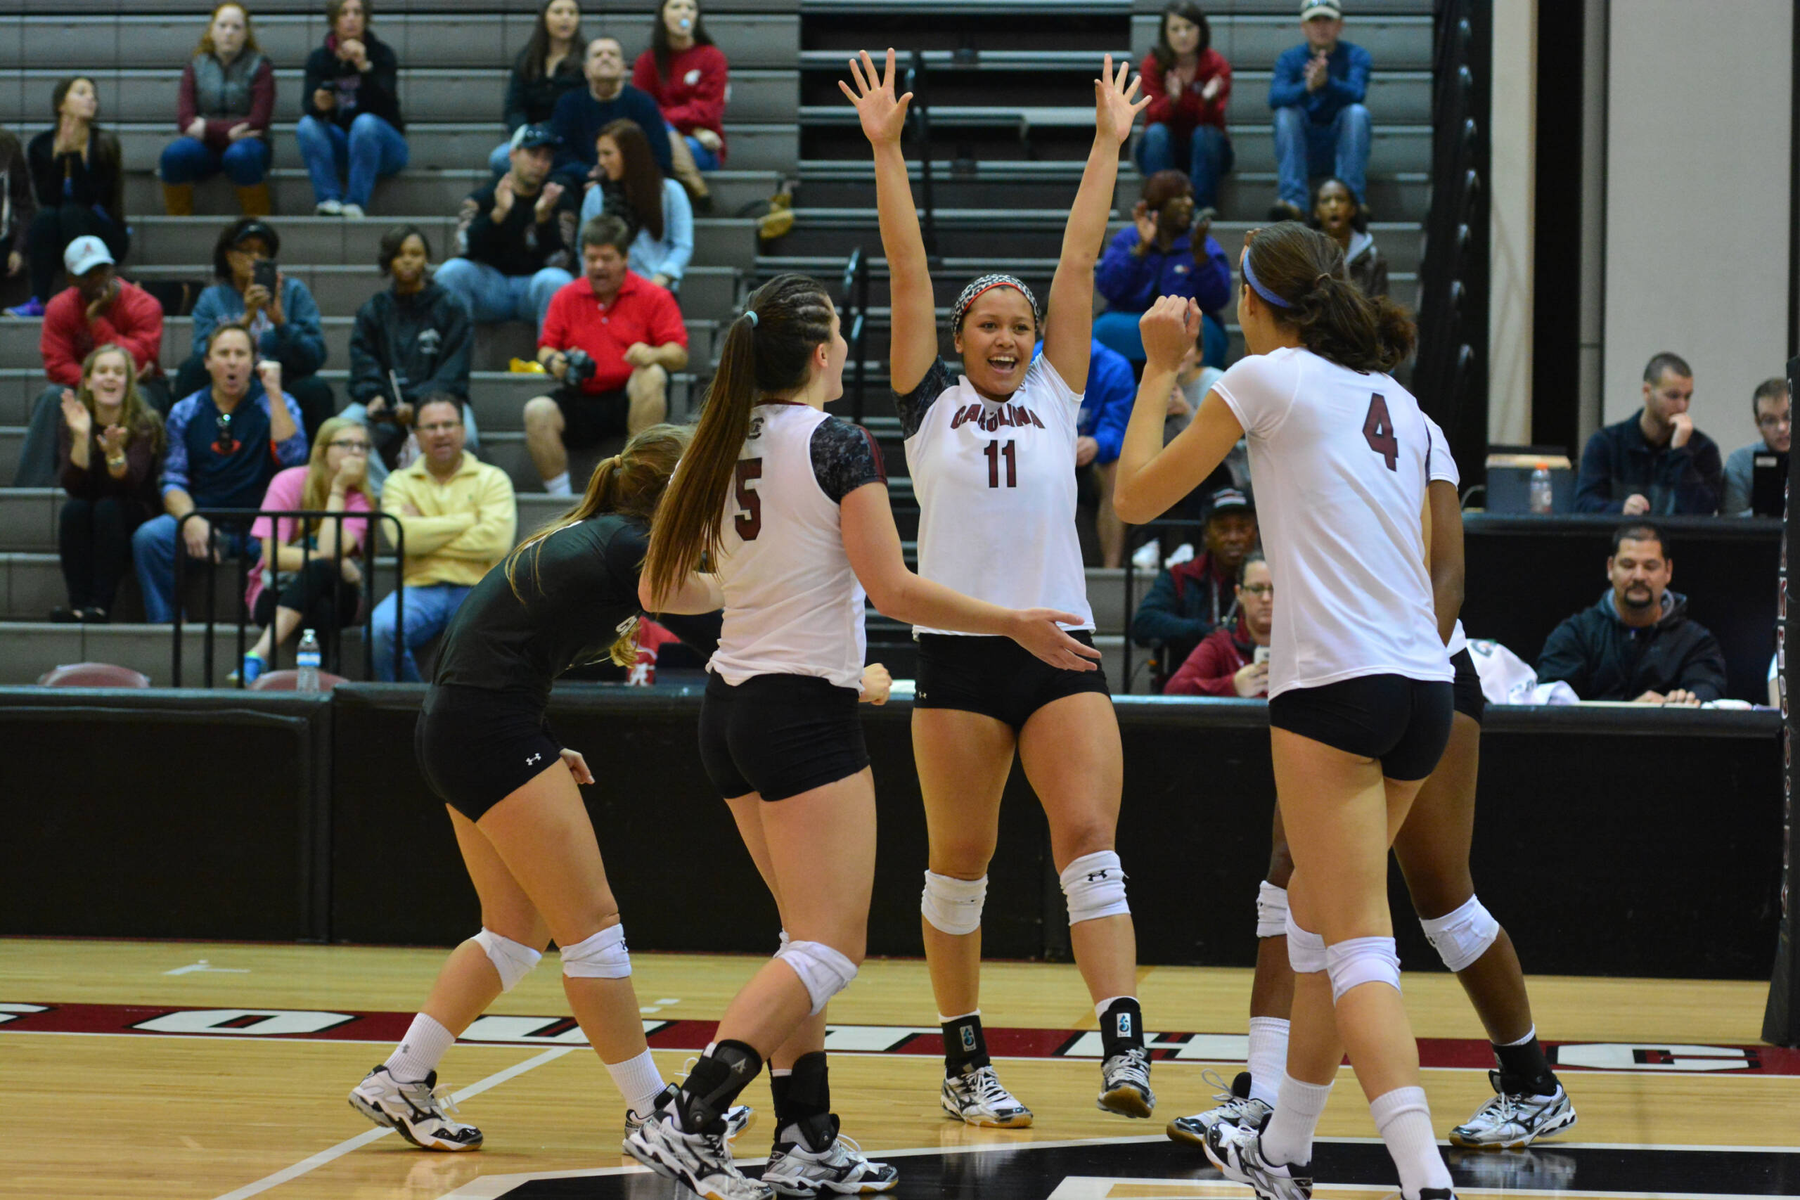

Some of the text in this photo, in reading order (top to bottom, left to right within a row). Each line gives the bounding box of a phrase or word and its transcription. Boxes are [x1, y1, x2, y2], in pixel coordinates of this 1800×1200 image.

[950, 402, 1046, 433] CAROLINA
[1362, 392, 1399, 472] 4
[983, 439, 1017, 488] 11
[734, 457, 762, 541] 5
[0, 1002, 1252, 1058] OUTH
